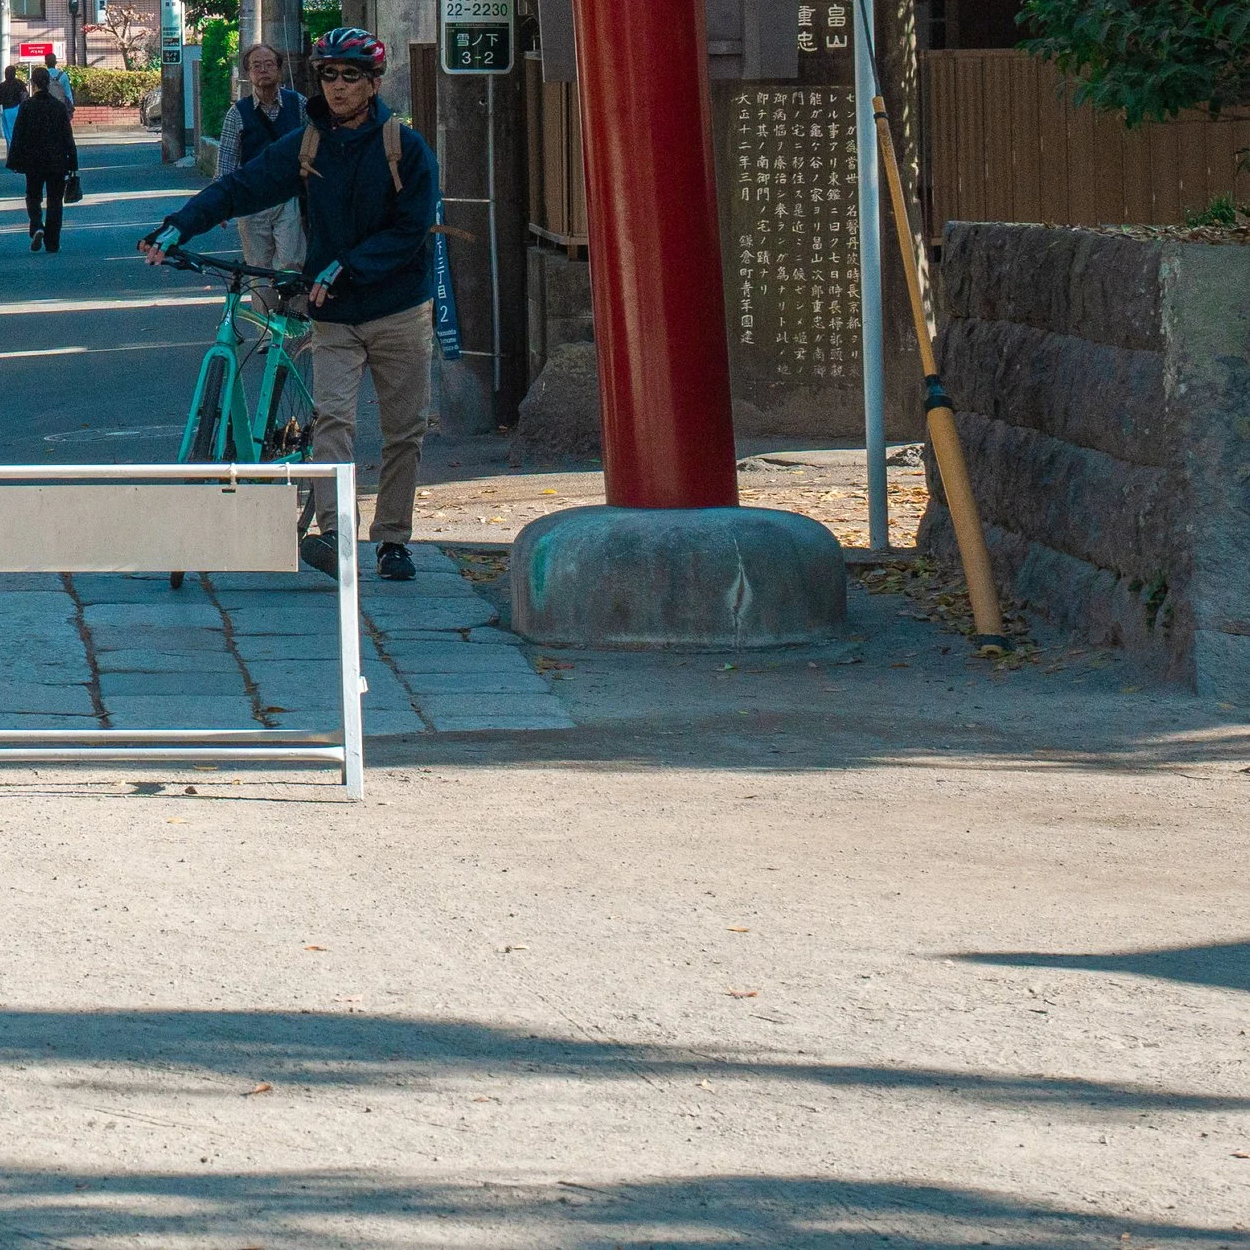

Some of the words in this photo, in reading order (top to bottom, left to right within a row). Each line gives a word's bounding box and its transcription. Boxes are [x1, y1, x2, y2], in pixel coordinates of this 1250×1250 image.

[447, 3, 508, 16] 22-2230
[797, 5, 818, 52] 重忠
[826, 3, 848, 48] 畠山
[456, 33, 499, 47] 雪ノ下
[461, 51, 494, 64] 3-2
[439, 305, 449, 323] 2
